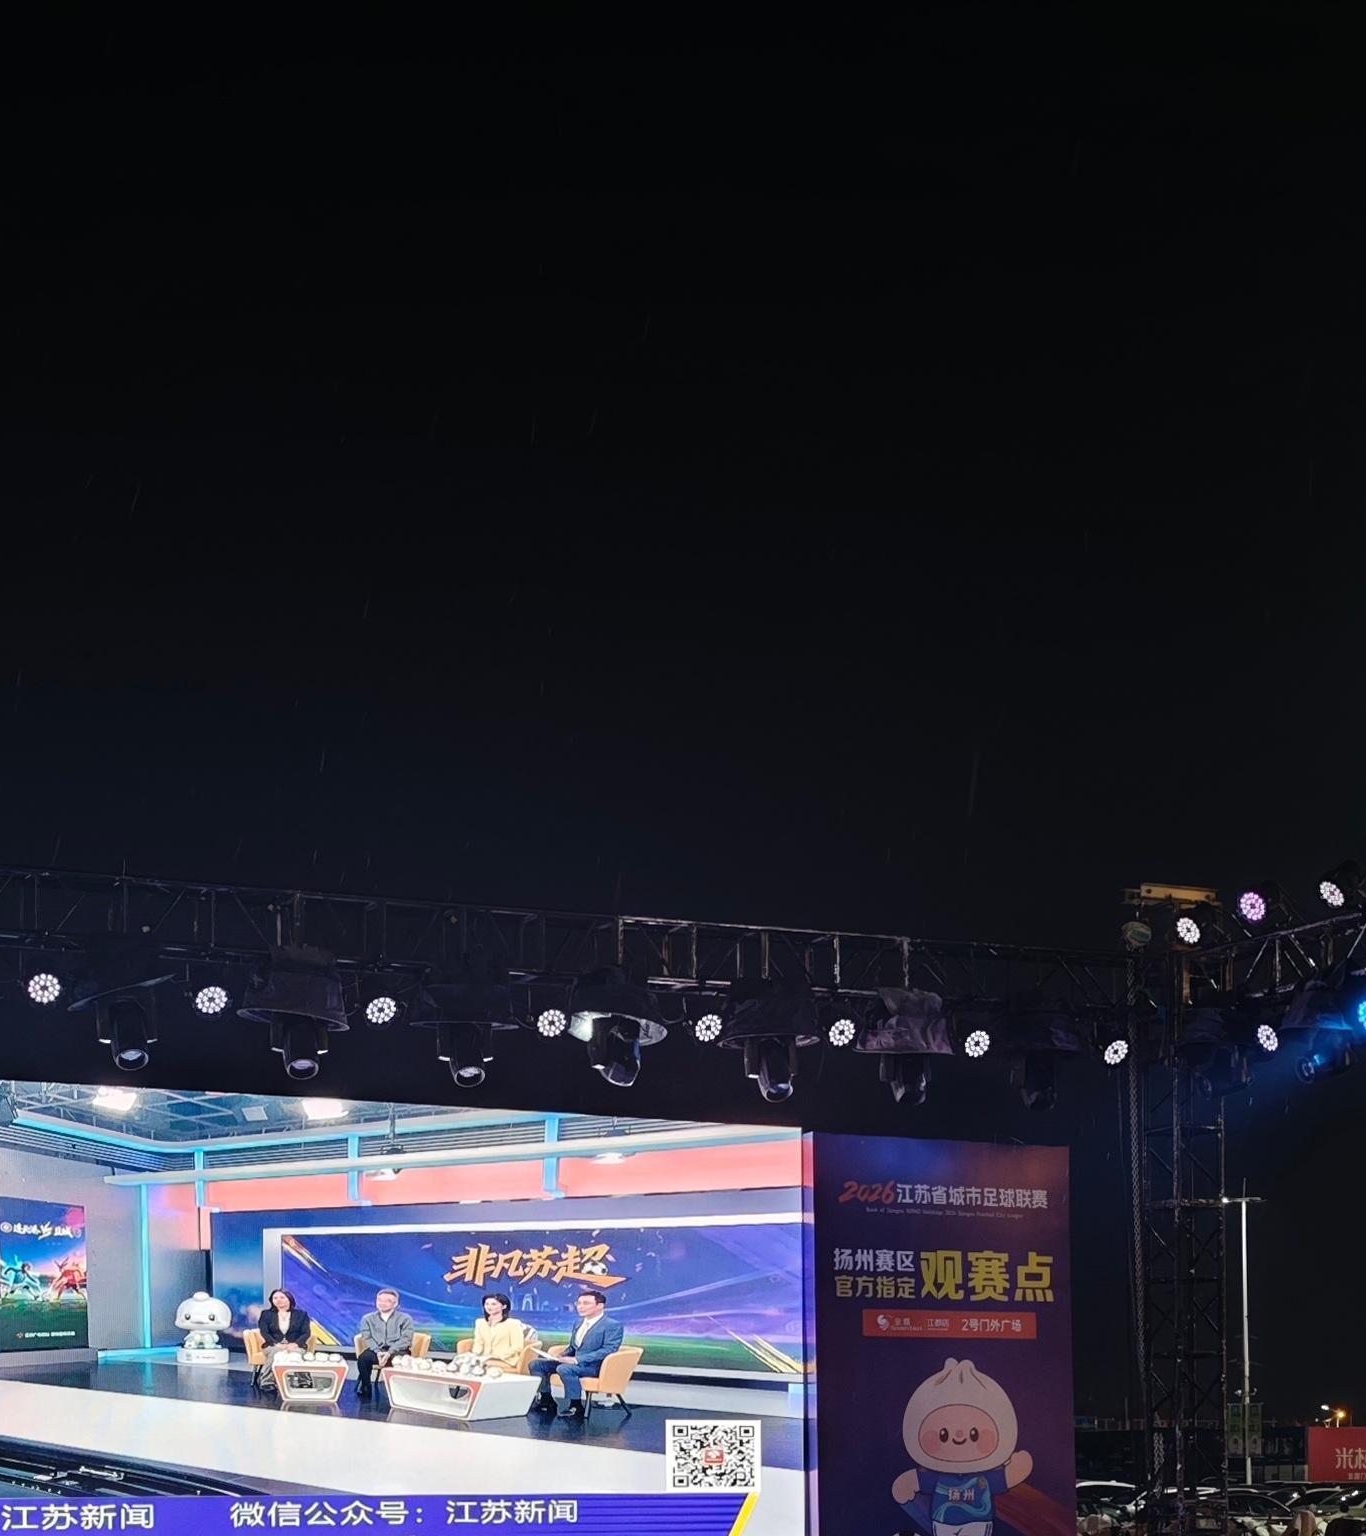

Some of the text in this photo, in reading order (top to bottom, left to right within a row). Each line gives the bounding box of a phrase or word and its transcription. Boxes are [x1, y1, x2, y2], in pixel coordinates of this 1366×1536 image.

[442, 1242, 628, 1288] 非凡苏超
[833, 1248, 916, 1273] 扬州赛区
[834, 1275, 916, 1299] 官方指定
[920, 1250, 1055, 1302] 观赛点
[961, 1318, 1022, 1333] 2号门外广场
